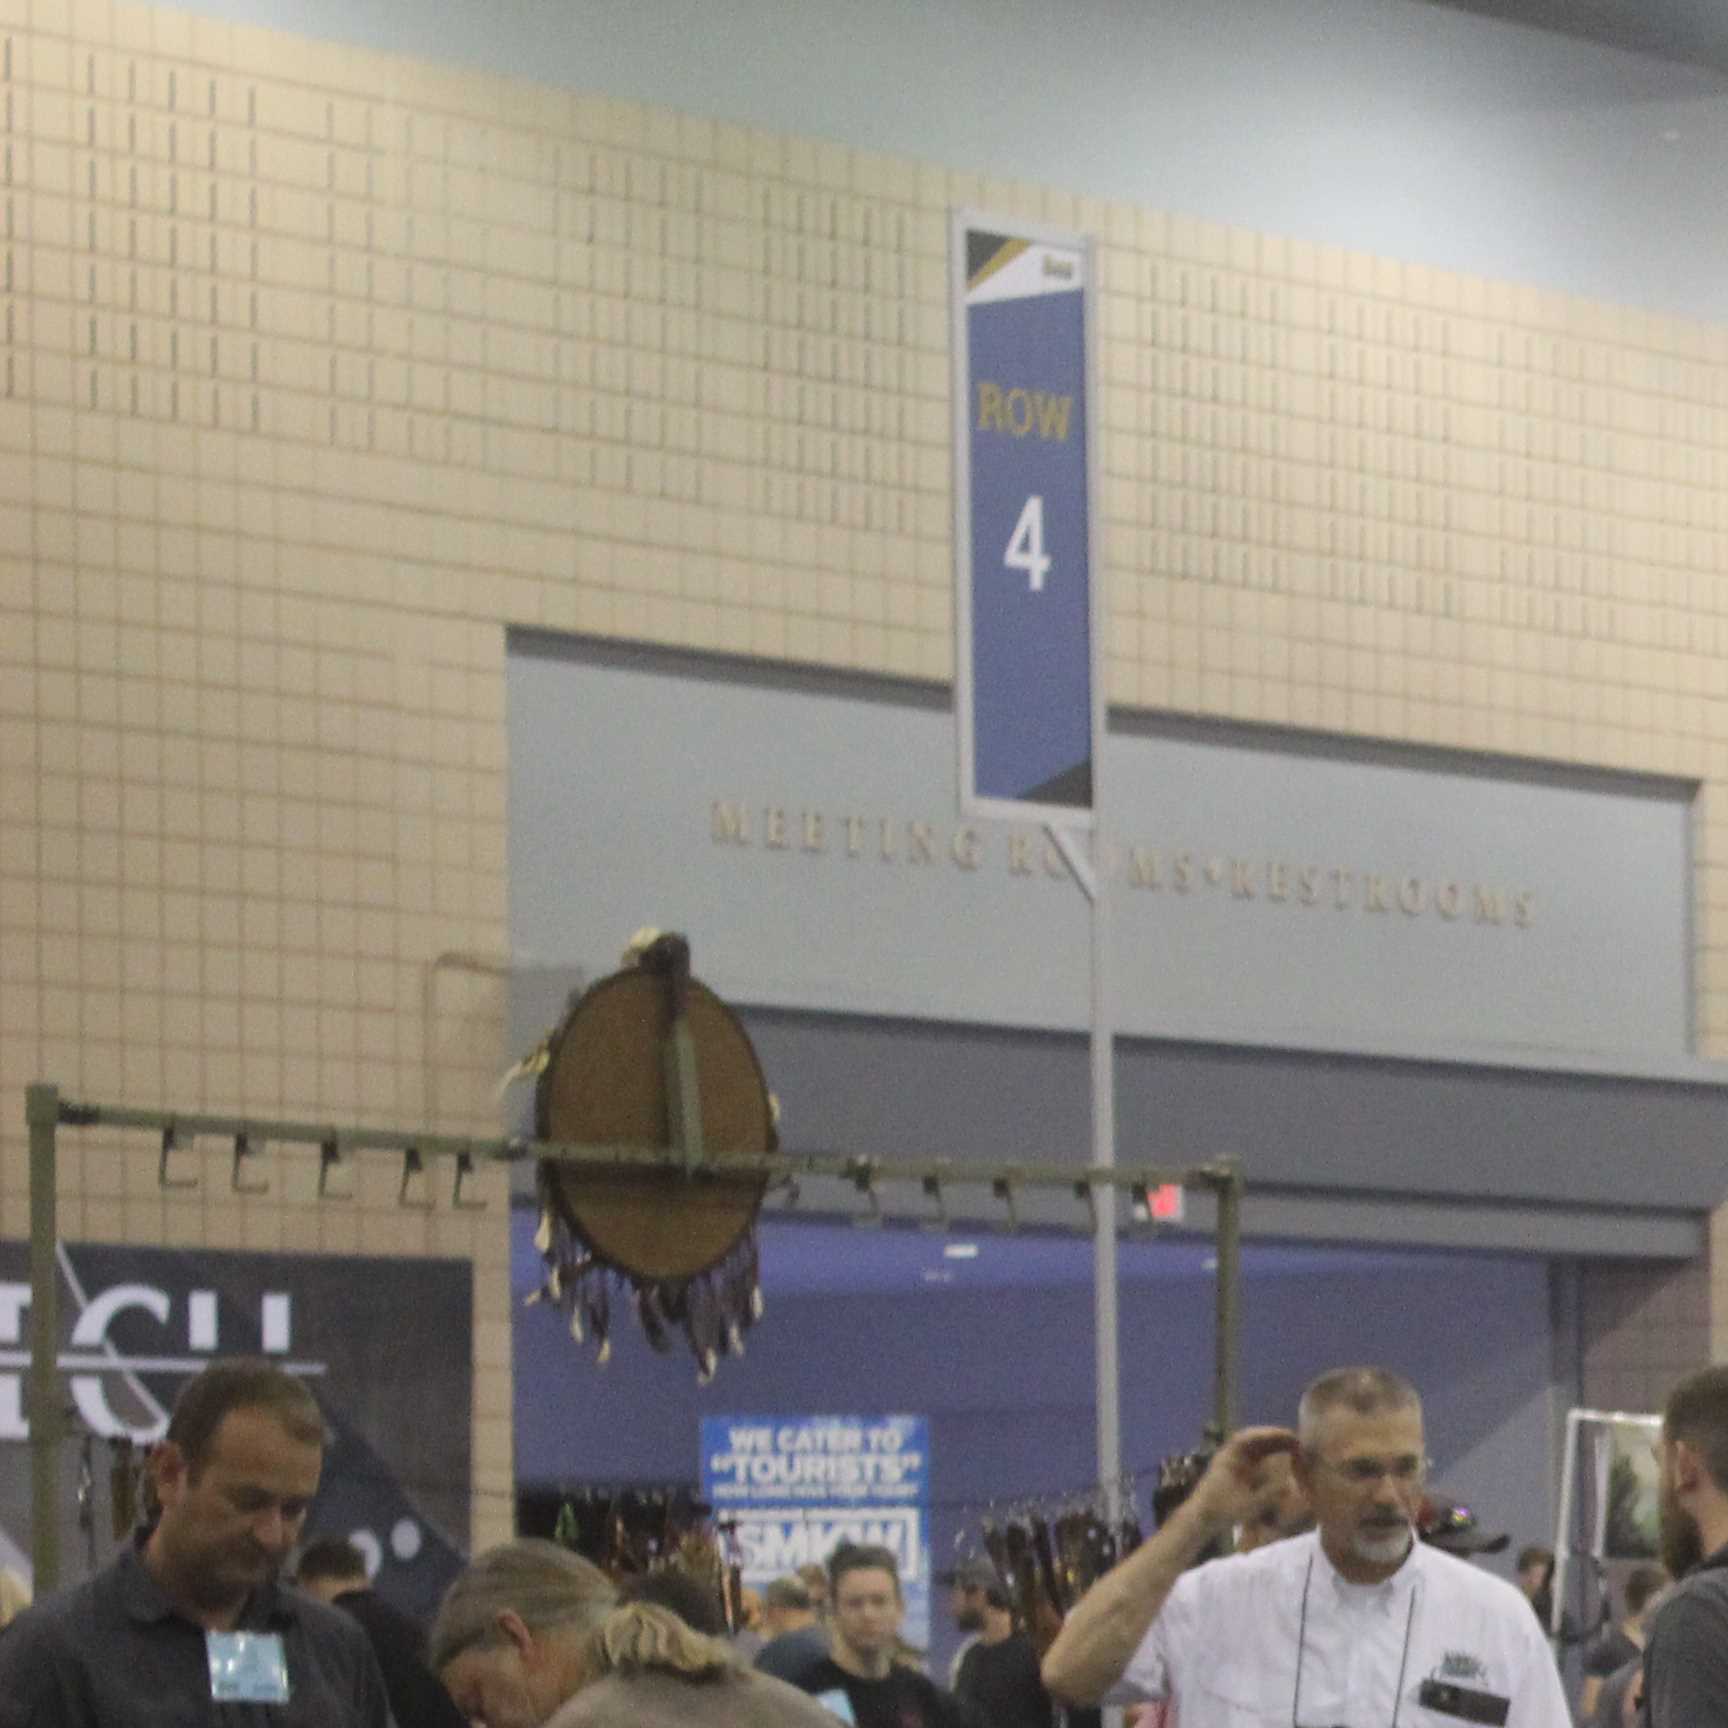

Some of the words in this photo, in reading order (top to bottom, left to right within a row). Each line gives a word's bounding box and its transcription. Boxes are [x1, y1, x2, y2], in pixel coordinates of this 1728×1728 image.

[975, 381, 1073, 442] ROW
[1004, 495, 1051, 591] 4
[710, 800, 984, 870] MEETING
[1008, 829, 1192, 894] ROMS
[1230, 857, 1538, 927] RESTROOMS
[730, 1427, 772, 1450] WE
[777, 1427, 862, 1451] CATER
[869, 1427, 903, 1450] TO
